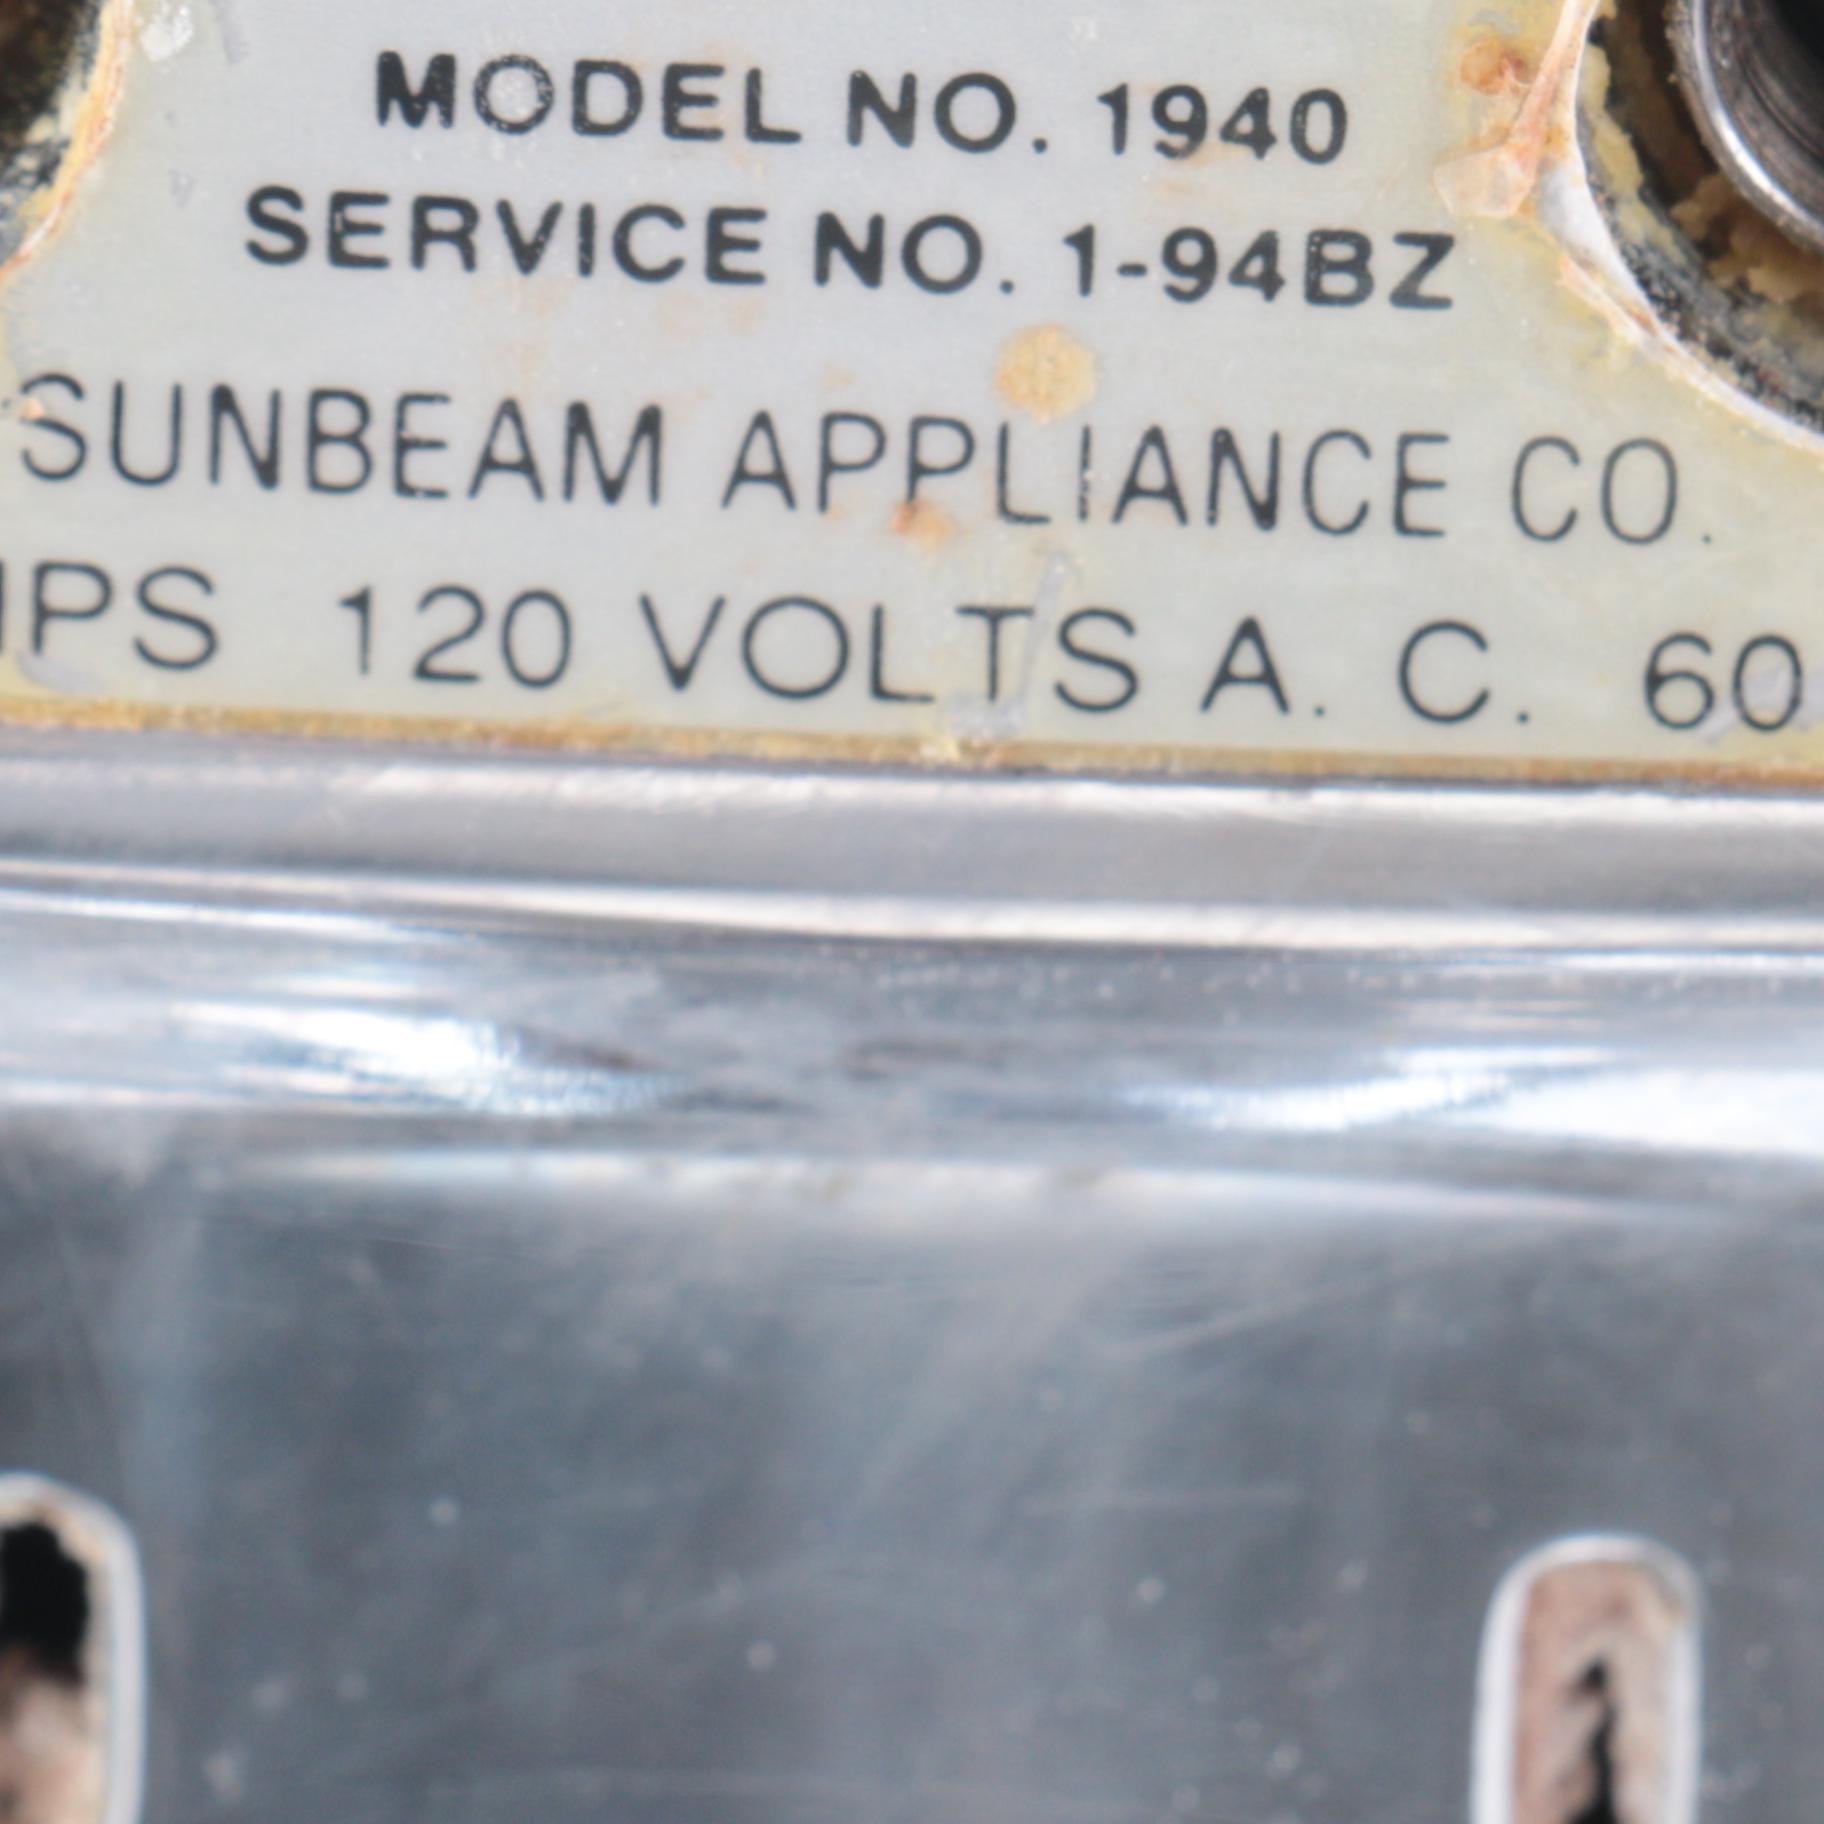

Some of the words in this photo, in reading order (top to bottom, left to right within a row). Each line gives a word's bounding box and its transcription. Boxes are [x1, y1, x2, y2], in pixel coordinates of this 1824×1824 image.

[375, 50, 802, 145] MODEL
[847, 71, 1048, 154] NO.
[1098, 83, 1348, 165] 1940
[246, 184, 767, 285] SERVICE
[814, 211, 1017, 294] NO.
[1064, 224, 1455, 309] 1-94BZ
[21, 372, 663, 505] SUNBEAM
[723, 411, 1447, 537] APPLIANCE
[1512, 437, 1717, 546] CO.
[342, 585, 571, 689] 120
[640, 596, 1138, 713] VOLTS
[1644, 632, 1803, 733] 60
